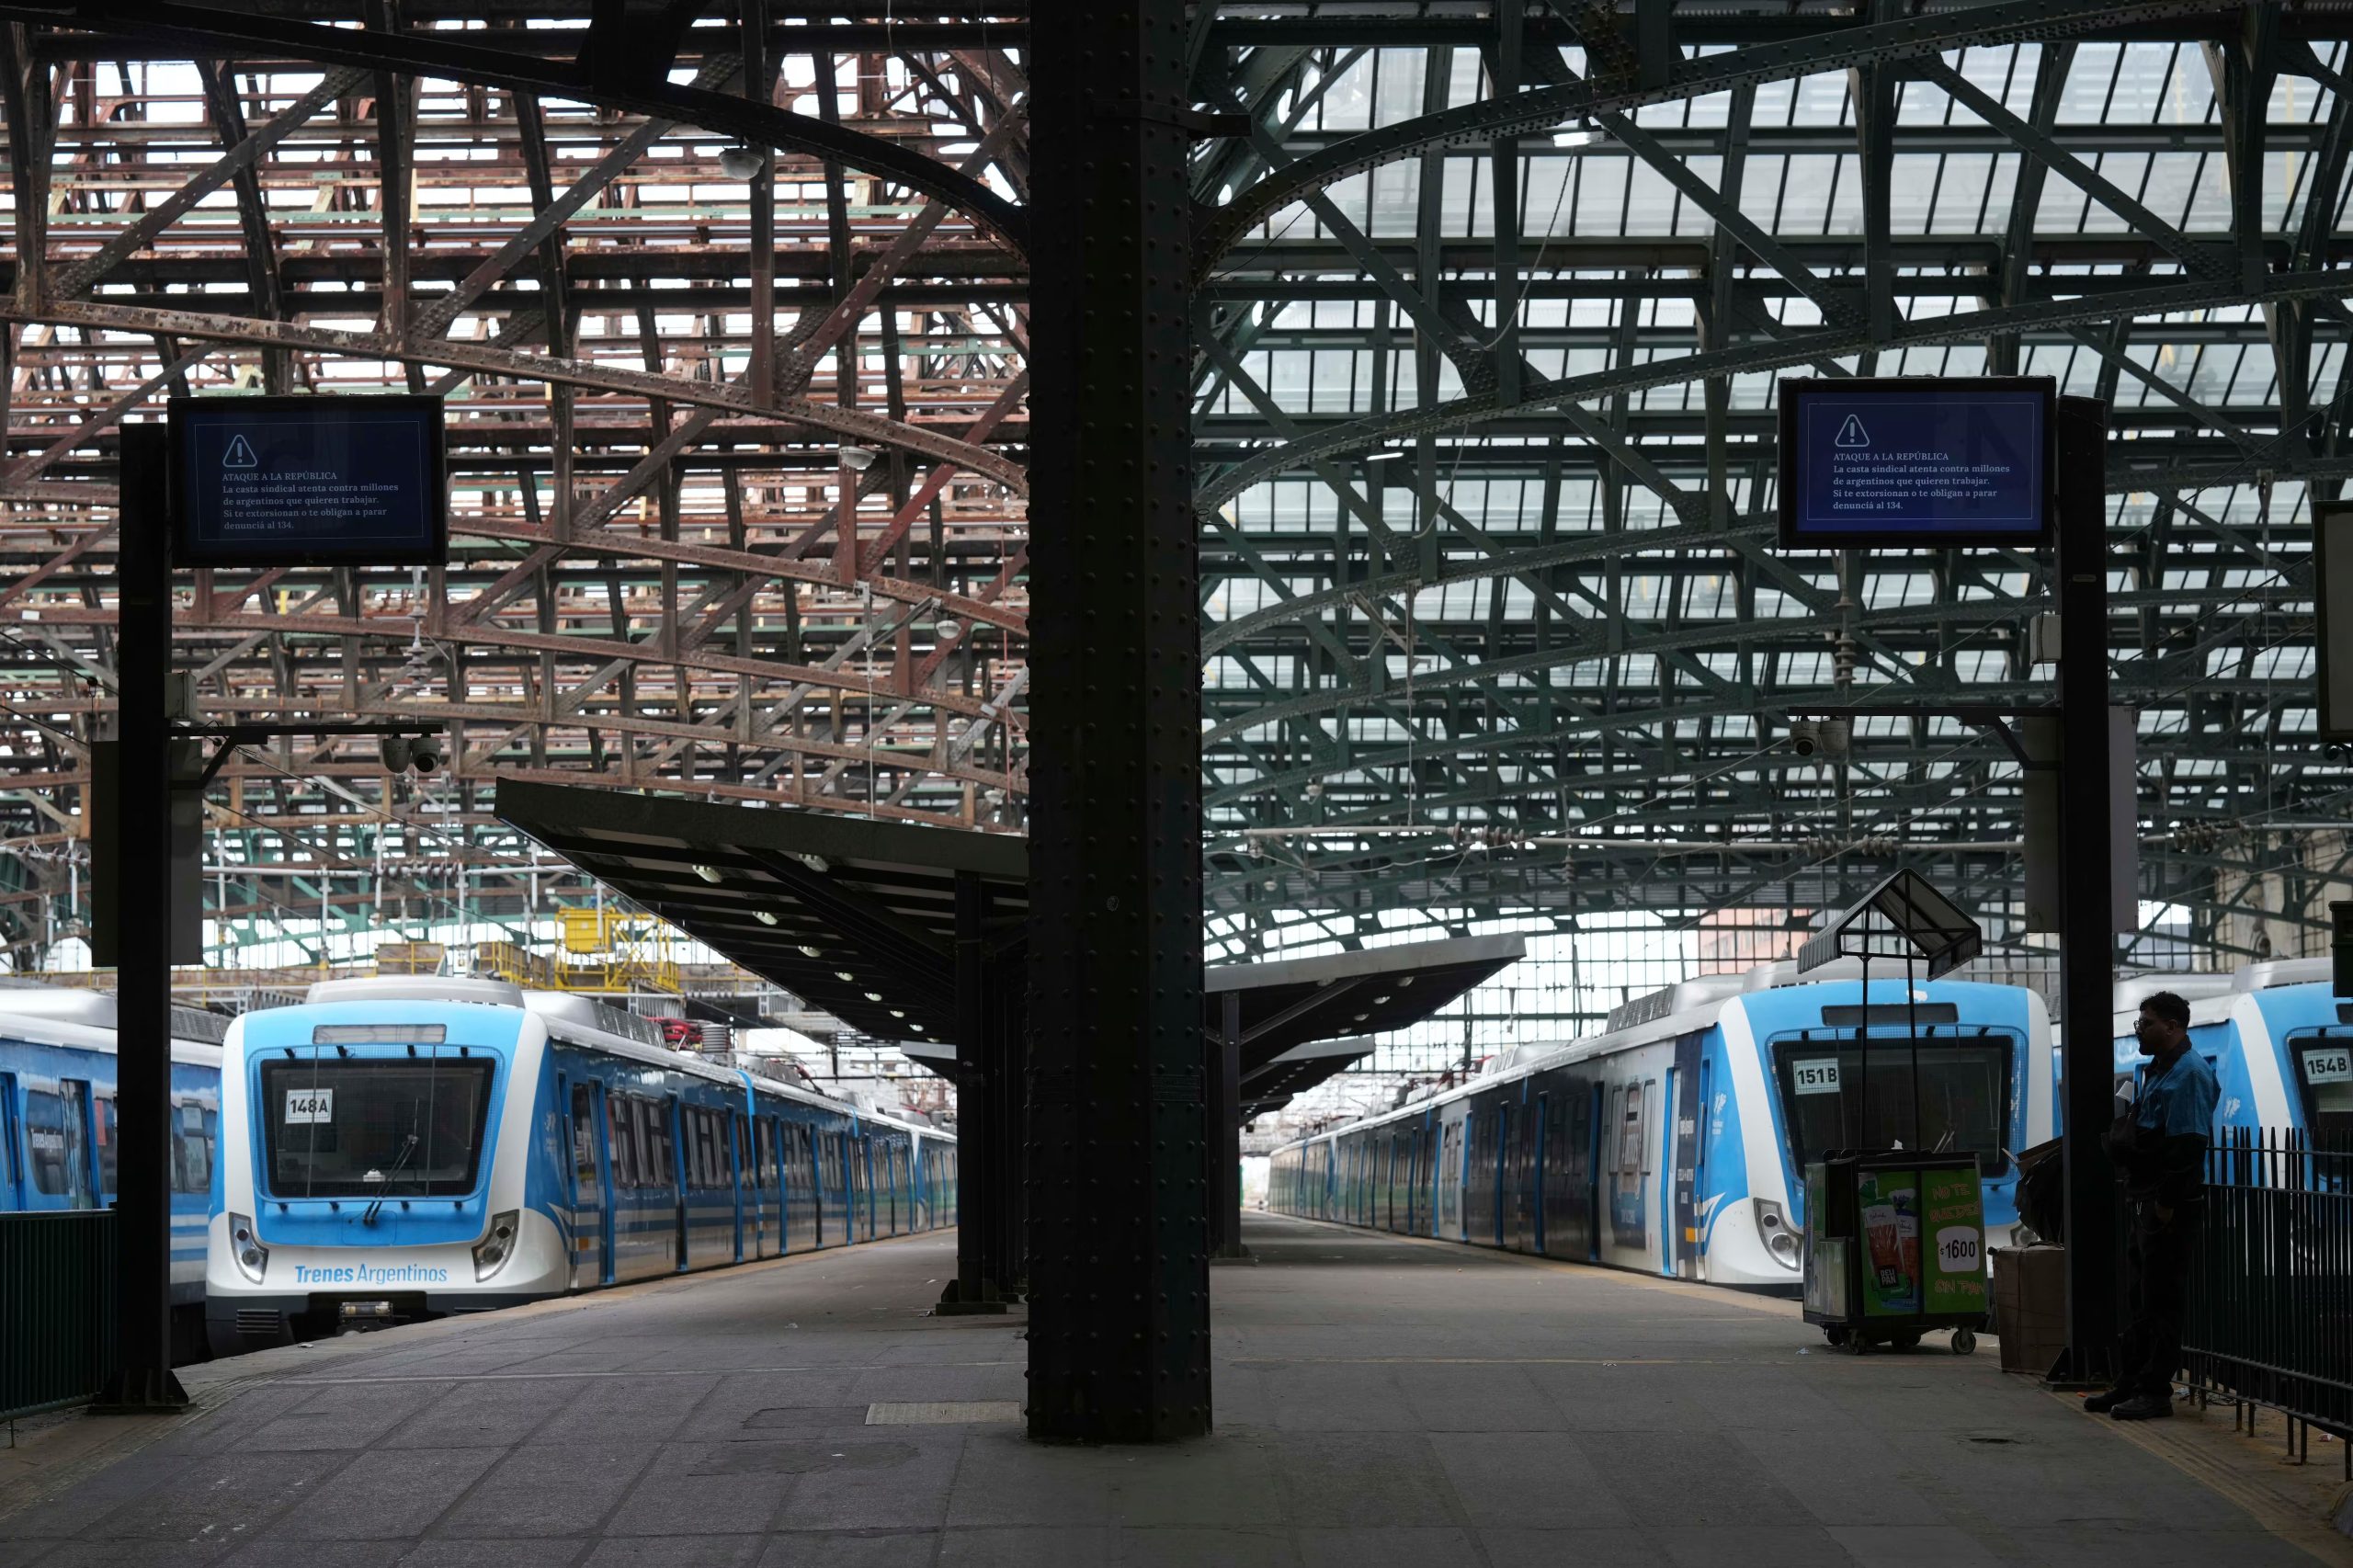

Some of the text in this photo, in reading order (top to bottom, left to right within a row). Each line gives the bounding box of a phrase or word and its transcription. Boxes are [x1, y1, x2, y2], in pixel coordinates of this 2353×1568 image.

[1834, 453, 1870, 462] ATAQUE
[1896, 451, 1949, 460] REPÚBLICA
[1872, 465, 1907, 473] sindical
[1972, 464, 2010, 472] millones
[222, 473, 258, 483] ATAQUE
[285, 471, 336, 481] REPÚBLICA
[1833, 476, 1990, 487] de argentinos que quieren trabajar.
[235, 485, 258, 494] casta
[261, 484, 296, 493] sindical
[299, 484, 326, 493] atenta
[360, 483, 399, 492] millones
[1833, 489, 1842, 497] Si
[1930, 489, 1963, 498] obligan
[223, 495, 380, 507] de argentinos que quieren trabajar.
[1833, 501, 1903, 509] denunciá al 134.
[223, 509, 233, 517] Si
[246, 508, 299, 517] extorsionan
[321, 507, 353, 517] obligan
[363, 509, 387, 517] parar
[224, 521, 294, 529] denunciá al 134.
[2308, 1057, 2347, 1074] 154B
[1798, 1068, 1836, 1085] 151B
[290, 1098, 328, 1114] 148A
[295, 1264, 448, 1285] Trenes Argentinos
